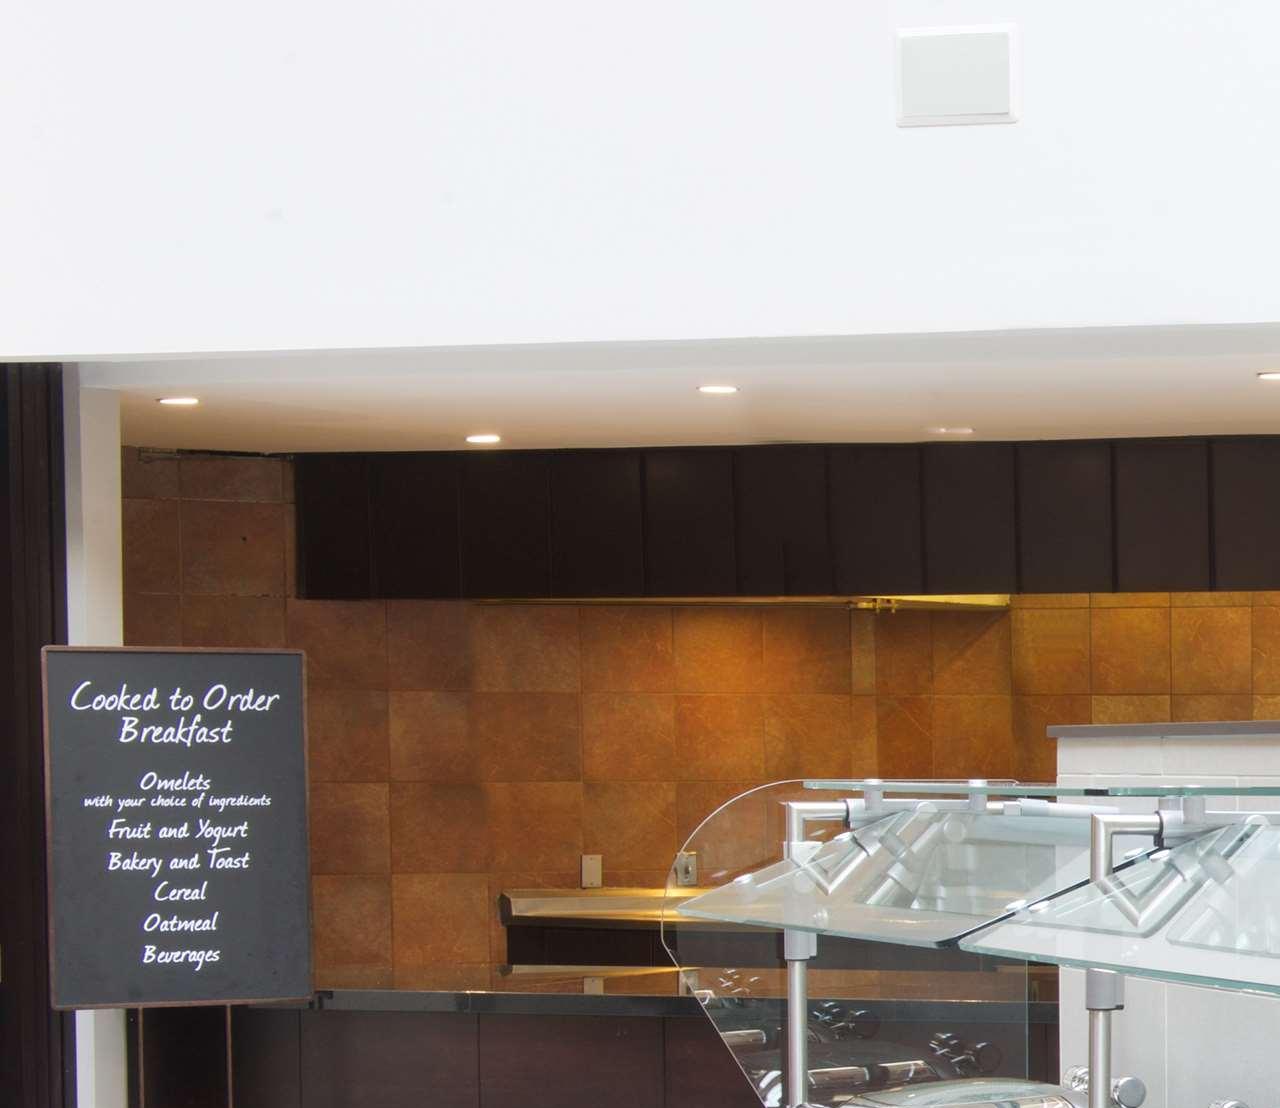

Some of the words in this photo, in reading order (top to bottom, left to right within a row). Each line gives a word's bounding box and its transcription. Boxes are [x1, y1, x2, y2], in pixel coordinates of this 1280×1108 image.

[71, 681, 160, 710] Cooked
[170, 691, 193, 710] to
[203, 685, 279, 711] Order
[120, 714, 232, 746] Breakfast
[140, 771, 210, 794] Omelets
[85, 795, 112, 807] with
[118, 798, 146, 812] your
[151, 795, 186, 806] choice
[192, 792, 205, 808] of
[209, 795, 271, 812] ingredients
[109, 819, 151, 839] Fruit
[159, 823, 189, 838] and
[196, 819, 248, 846] Yogurt
[109, 852, 162, 877] Bakery
[170, 854, 200, 869] and
[208, 848, 249, 868] Toast
[155, 881, 207, 901] Cereal
[144, 912, 218, 931] Oatmeal
[143, 945, 220, 971] Beverages
